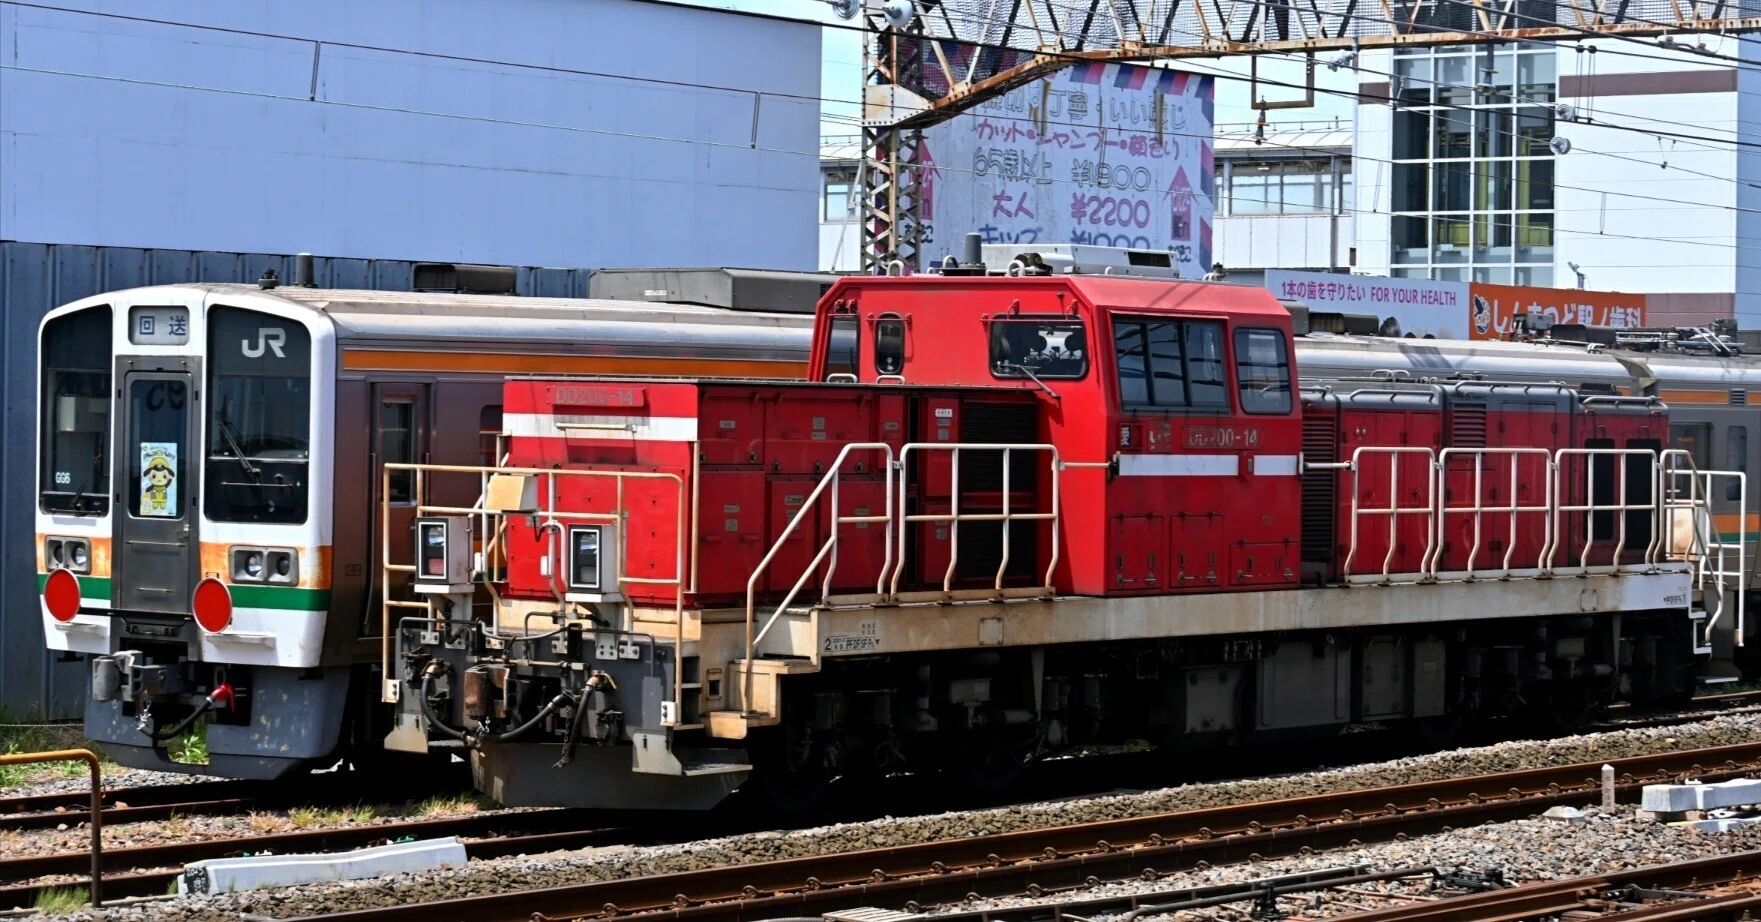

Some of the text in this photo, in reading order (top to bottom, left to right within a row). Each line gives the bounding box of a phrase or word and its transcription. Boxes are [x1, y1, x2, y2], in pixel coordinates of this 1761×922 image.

[973, 147, 1052, 184] 65歳以上
[1071, 159, 1151, 192] ¥1800
[993, 190, 1035, 220] 大人
[1071, 192, 1150, 228] ¥2200
[1281, 280, 1457, 306] 1本の歯を守りたい FOR YOUR HEALTH
[139, 315, 187, 336] 回送
[241, 327, 286, 358] JR
[556, 387, 634, 405] DD200-14
[55, 471, 71, 484] GG6
